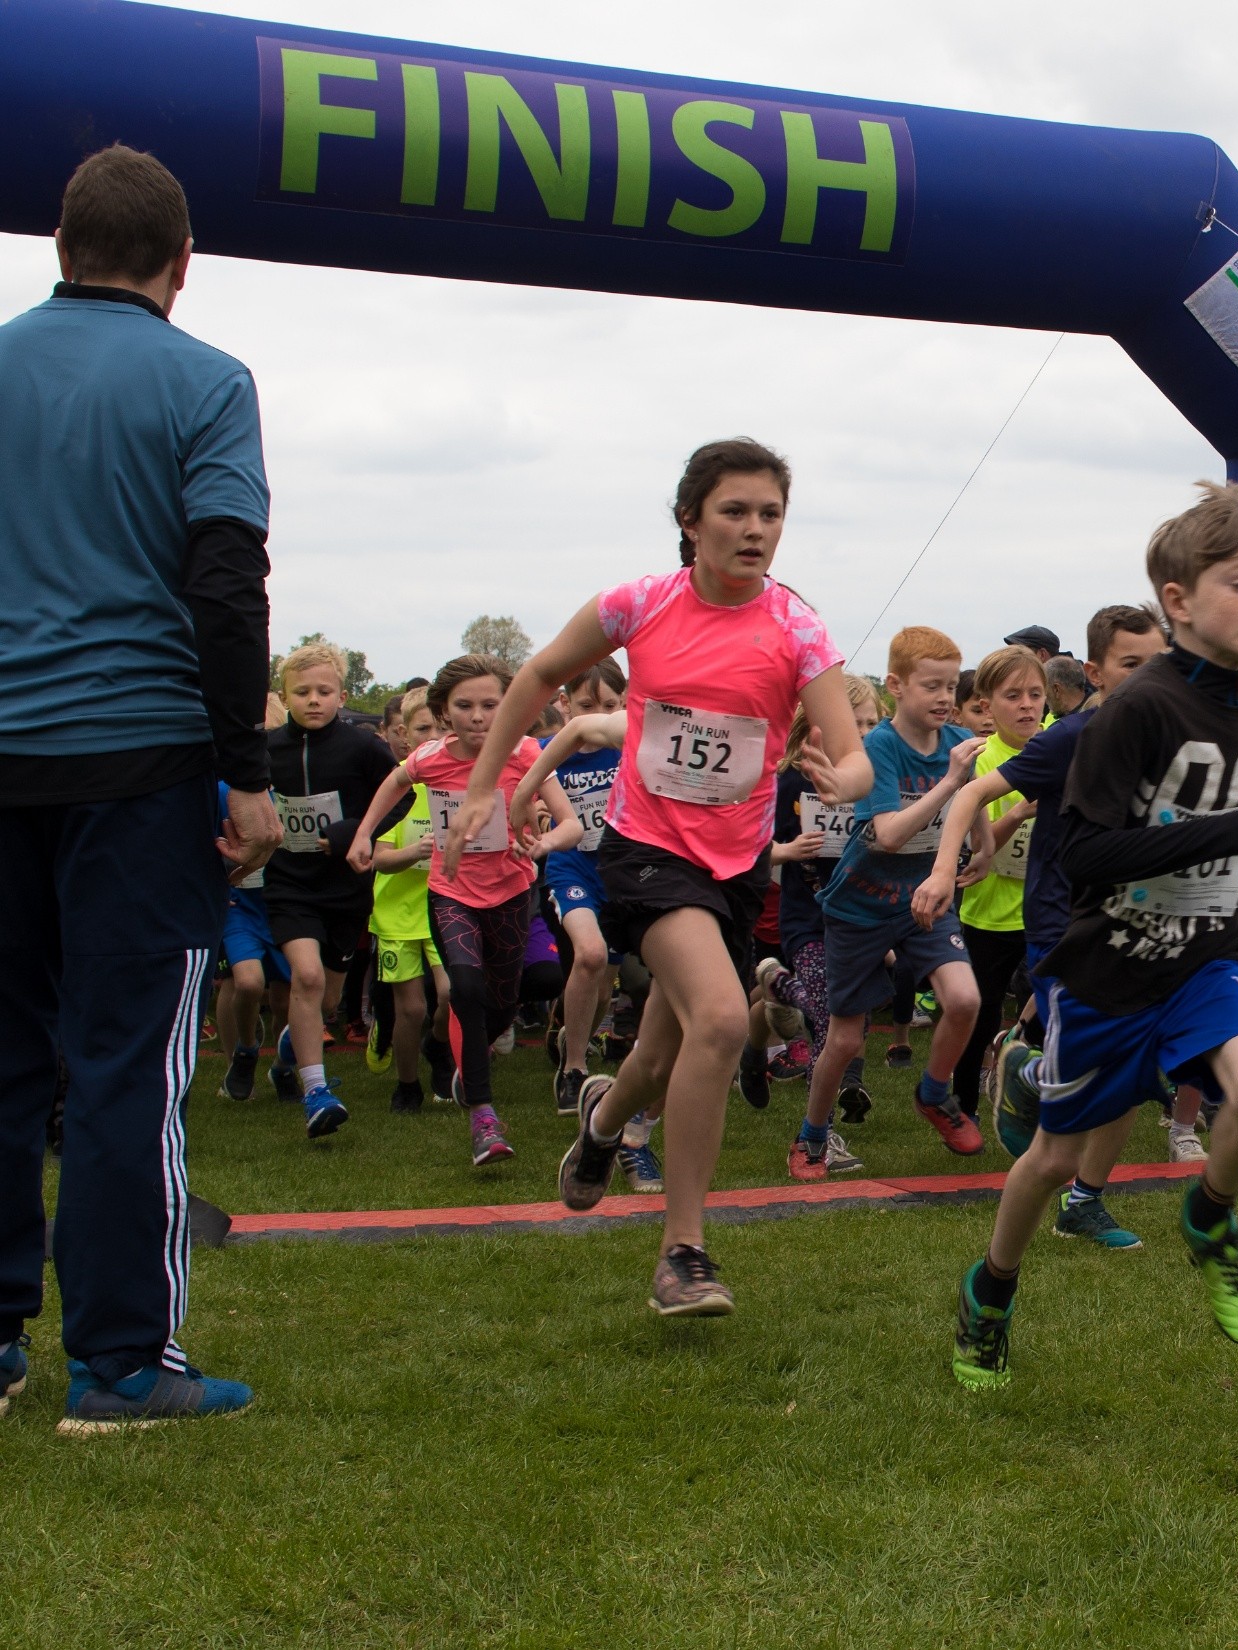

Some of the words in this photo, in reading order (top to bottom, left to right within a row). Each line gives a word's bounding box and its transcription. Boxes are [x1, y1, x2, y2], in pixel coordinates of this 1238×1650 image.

[280, 48, 897, 253] FINISH
[661, 704, 692, 718] YMCA
[680, 721, 703, 735] FUN
[706, 728, 730, 739] RUN
[667, 735, 732, 774] 152
[563, 772, 594, 789] JUST
[580, 802, 594, 811] FUN
[821, 805, 836, 813] FUN
[578, 810, 607, 831] 16
